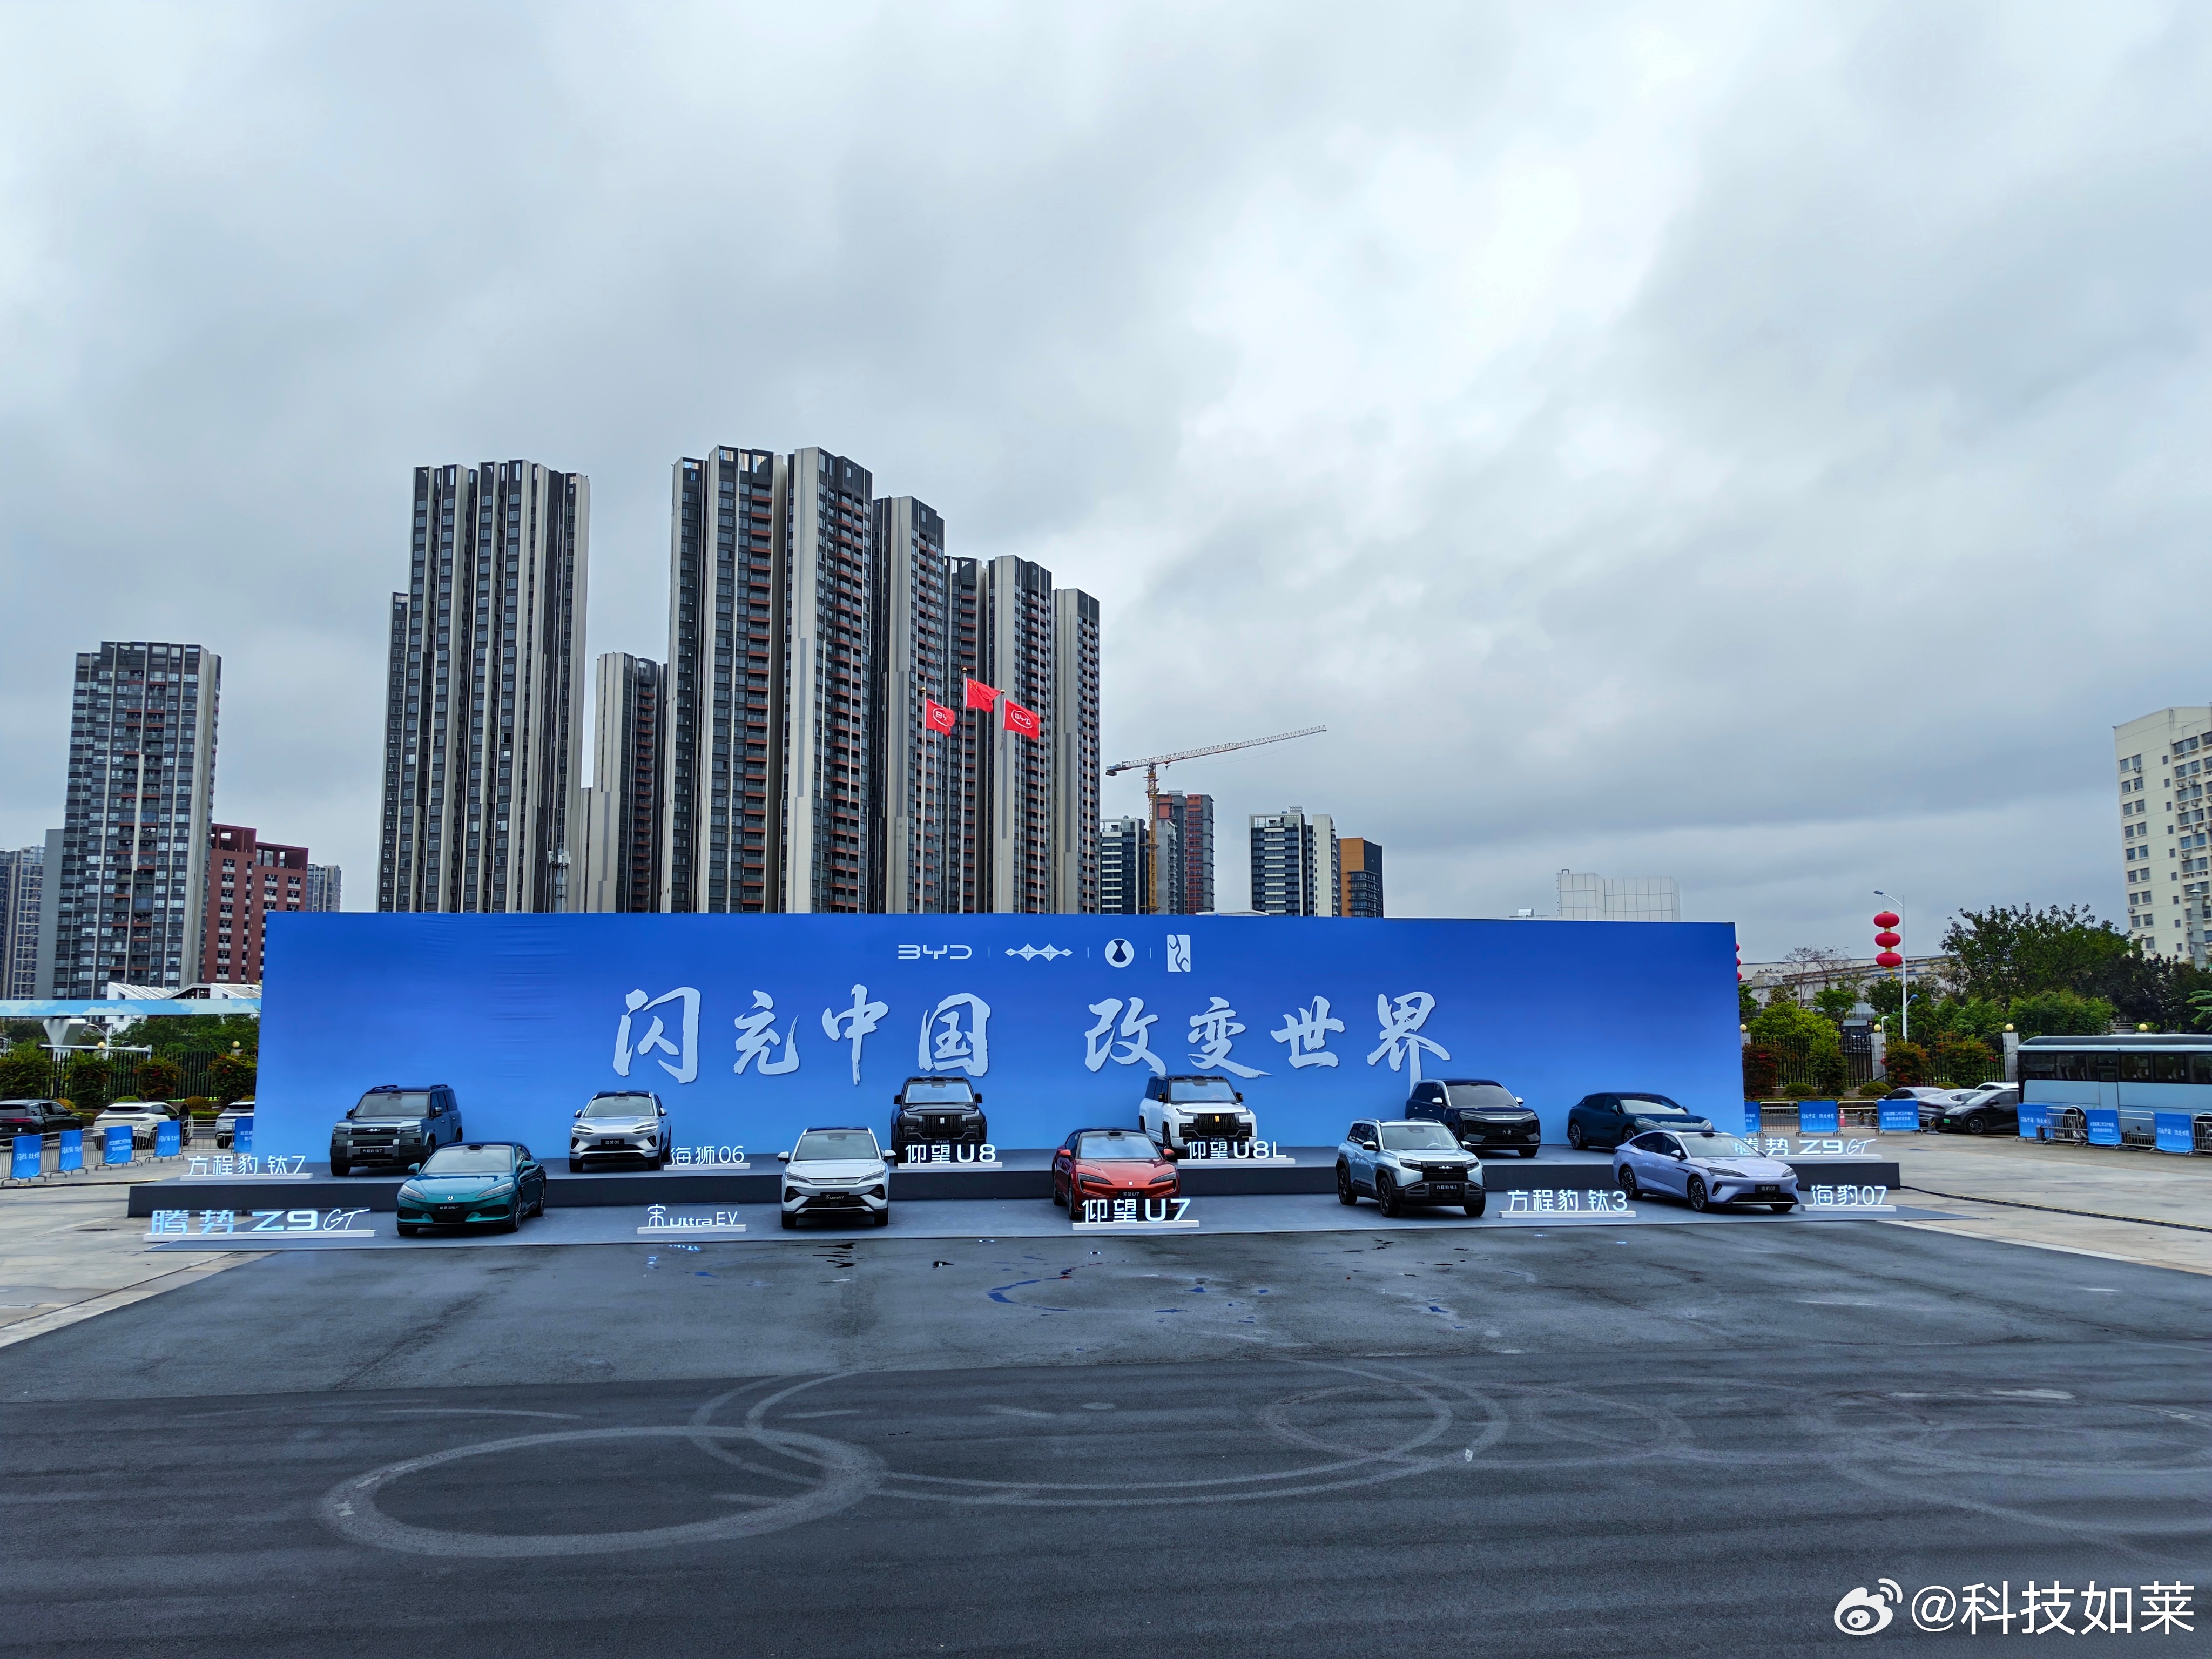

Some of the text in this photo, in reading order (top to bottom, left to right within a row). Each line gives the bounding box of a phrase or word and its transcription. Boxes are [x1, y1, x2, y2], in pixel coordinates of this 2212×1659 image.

[898, 945, 972, 960] BYD
[612, 983, 1451, 1095] 闪充中国 改变世界
[187, 1155, 306, 1175] 方程豹 钛7
[670, 1145, 745, 1165] 海狮06
[1507, 1189, 1628, 1212] 方程豹 钛3
[1811, 1184, 1887, 1206] 海豹07
[151, 1209, 234, 1235] 腾势
